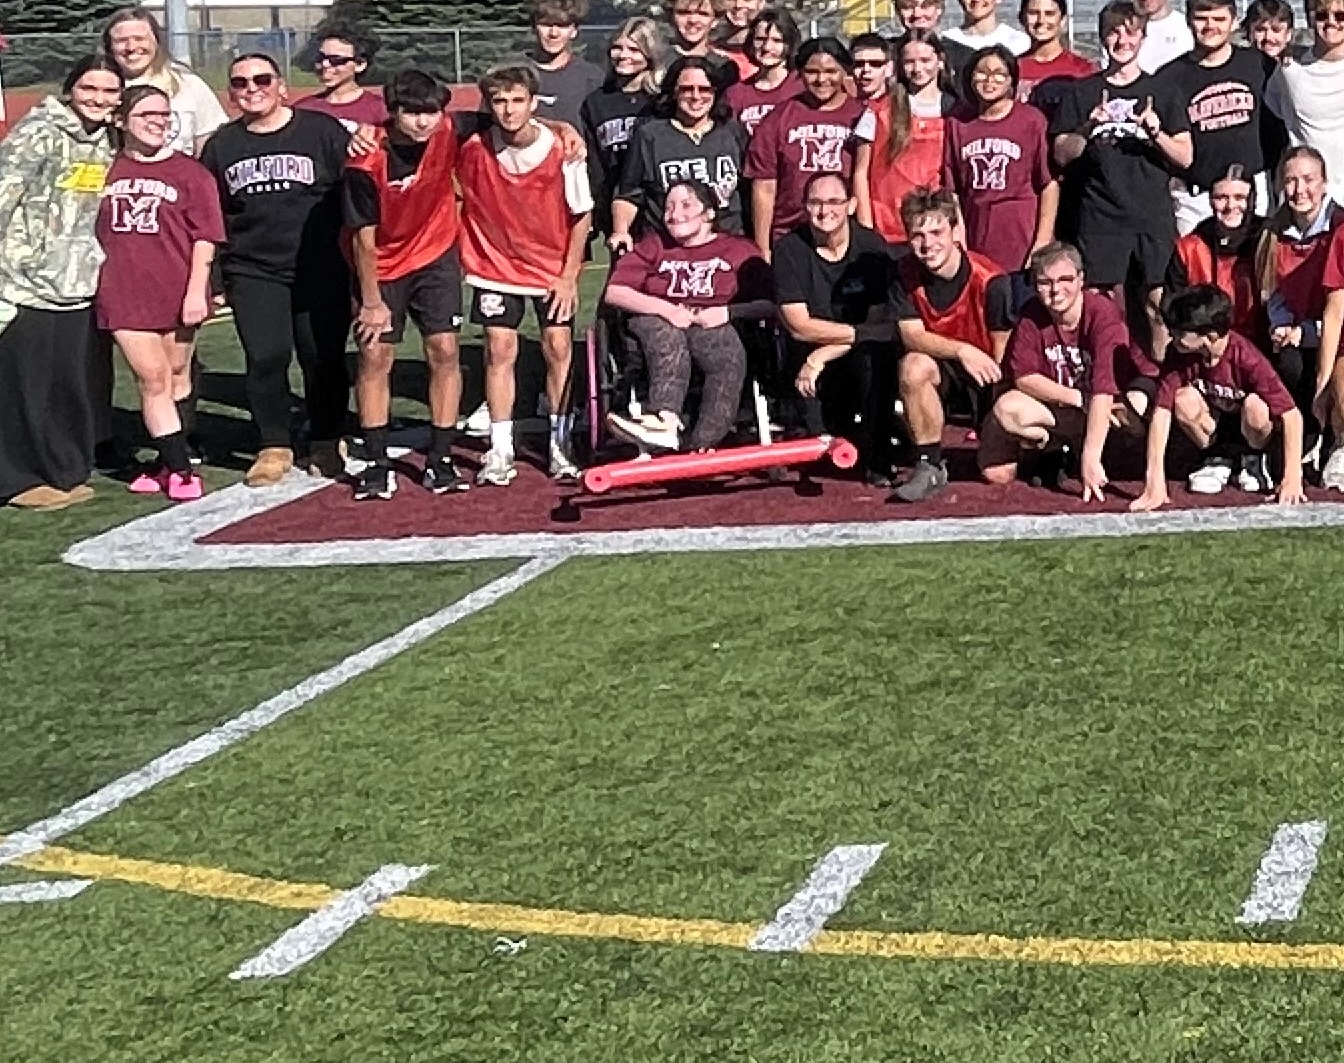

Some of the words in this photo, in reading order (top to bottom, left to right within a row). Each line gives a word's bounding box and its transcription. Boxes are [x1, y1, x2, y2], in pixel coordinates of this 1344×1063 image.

[961, 138, 1021, 161] MILFORD
[225, 155, 316, 195] MILFORD
[103, 178, 177, 203] MILFORD
